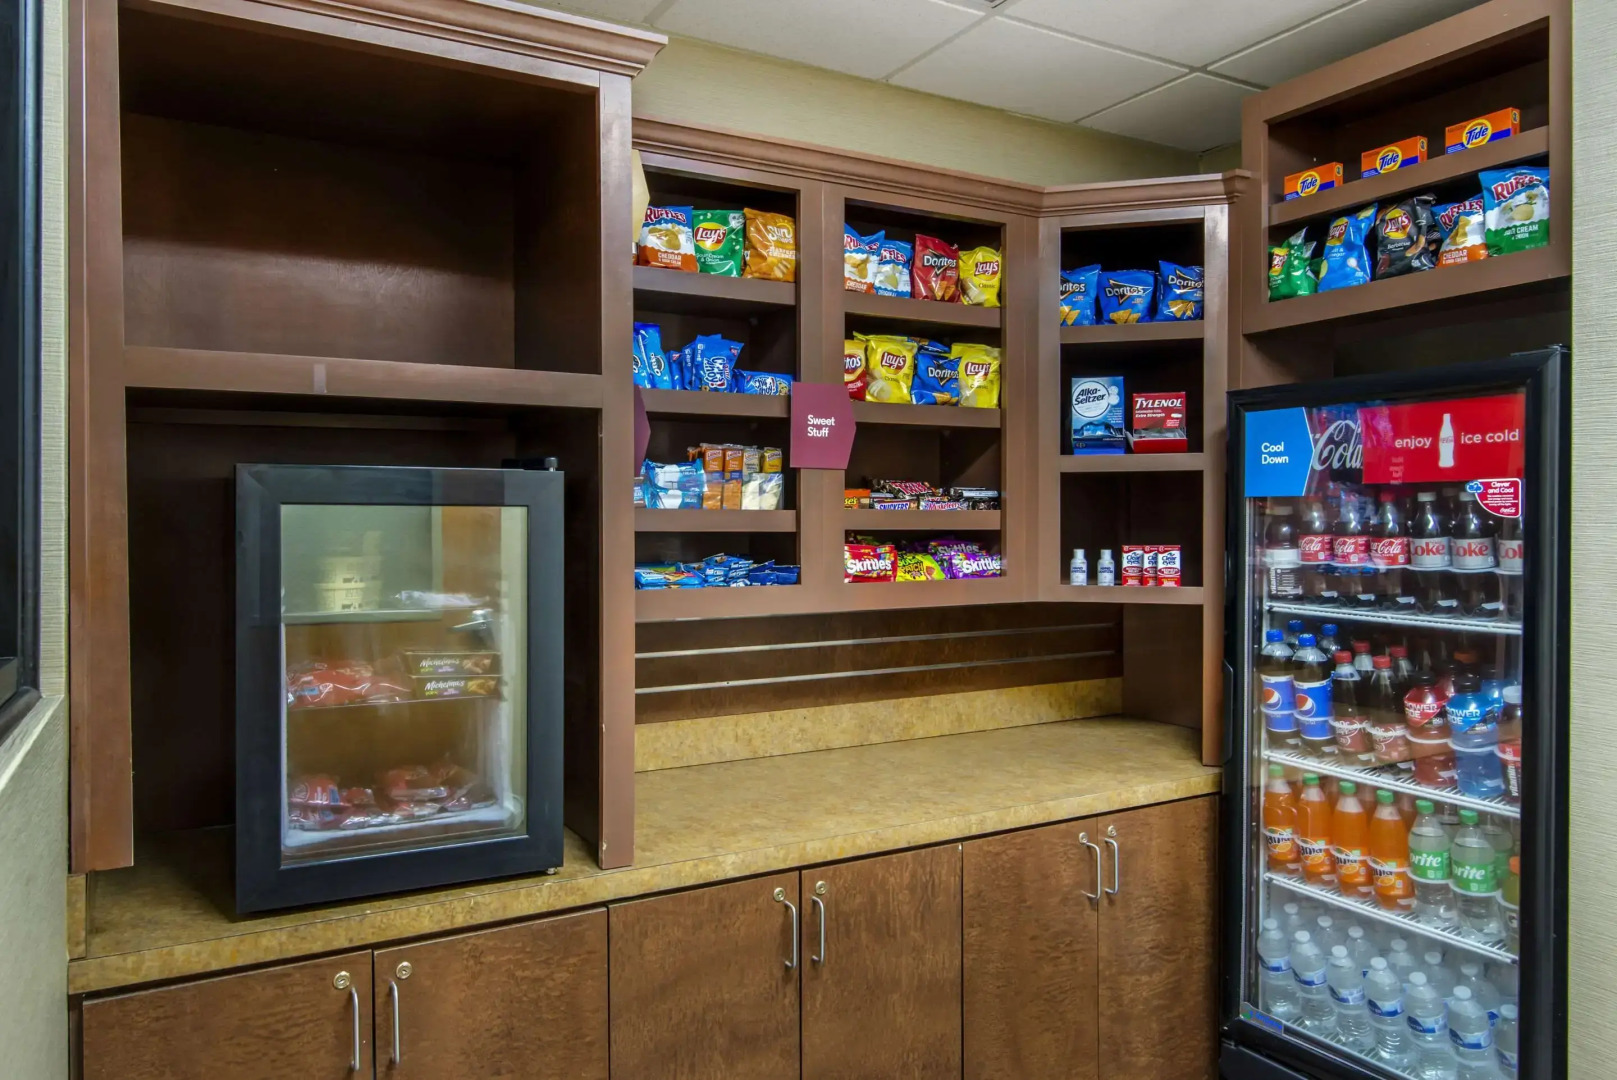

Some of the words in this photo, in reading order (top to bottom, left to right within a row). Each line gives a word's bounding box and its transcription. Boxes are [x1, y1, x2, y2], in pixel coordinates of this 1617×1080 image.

[1465, 126, 1489, 146] Tide
[1379, 151, 1399, 171] Tide
[1300, 177, 1318, 195] Tide
[644, 206, 687, 223] RUFFLES
[1440, 198, 1484, 231] RUFFLES
[767, 225, 793, 241] Sun
[1516, 224, 1539, 233] CREAM
[696, 228, 727, 244] Lay's
[657, 252, 682, 261] CHEDDAR
[1442, 249, 1468, 260] CHEDDAR
[924, 255, 957, 267] Doritos
[975, 261, 999, 275] Lay's
[1060, 282, 1086, 292] ritos
[1105, 286, 1144, 298] Doritos
[882, 352, 906, 370] Lay's
[928, 366, 959, 379] Doritos
[966, 362, 991, 377] Lay's
[1076, 387, 1101, 398] Alka-
[1074, 393, 1107, 406] Seltzer
[1135, 397, 1183, 409] TYLENOL
[807, 414, 836, 426] Sweet
[807, 426, 829, 437] Stuff
[1395, 435, 1432, 449] enjoy
[1461, 432, 1482, 444] ice
[1485, 428, 1520, 443] cold
[1261, 441, 1285, 453] Cool
[1261, 454, 1289, 465] Down
[844, 496, 858, 505] se's
[879, 502, 909, 510] SNICKERS
[938, 543, 980, 555] Skittles
[1410, 541, 1446, 556] Coke
[847, 557, 893, 574] Skittles
[962, 556, 1001, 574] Skittle
[424, 680, 466, 691] Michelina's
